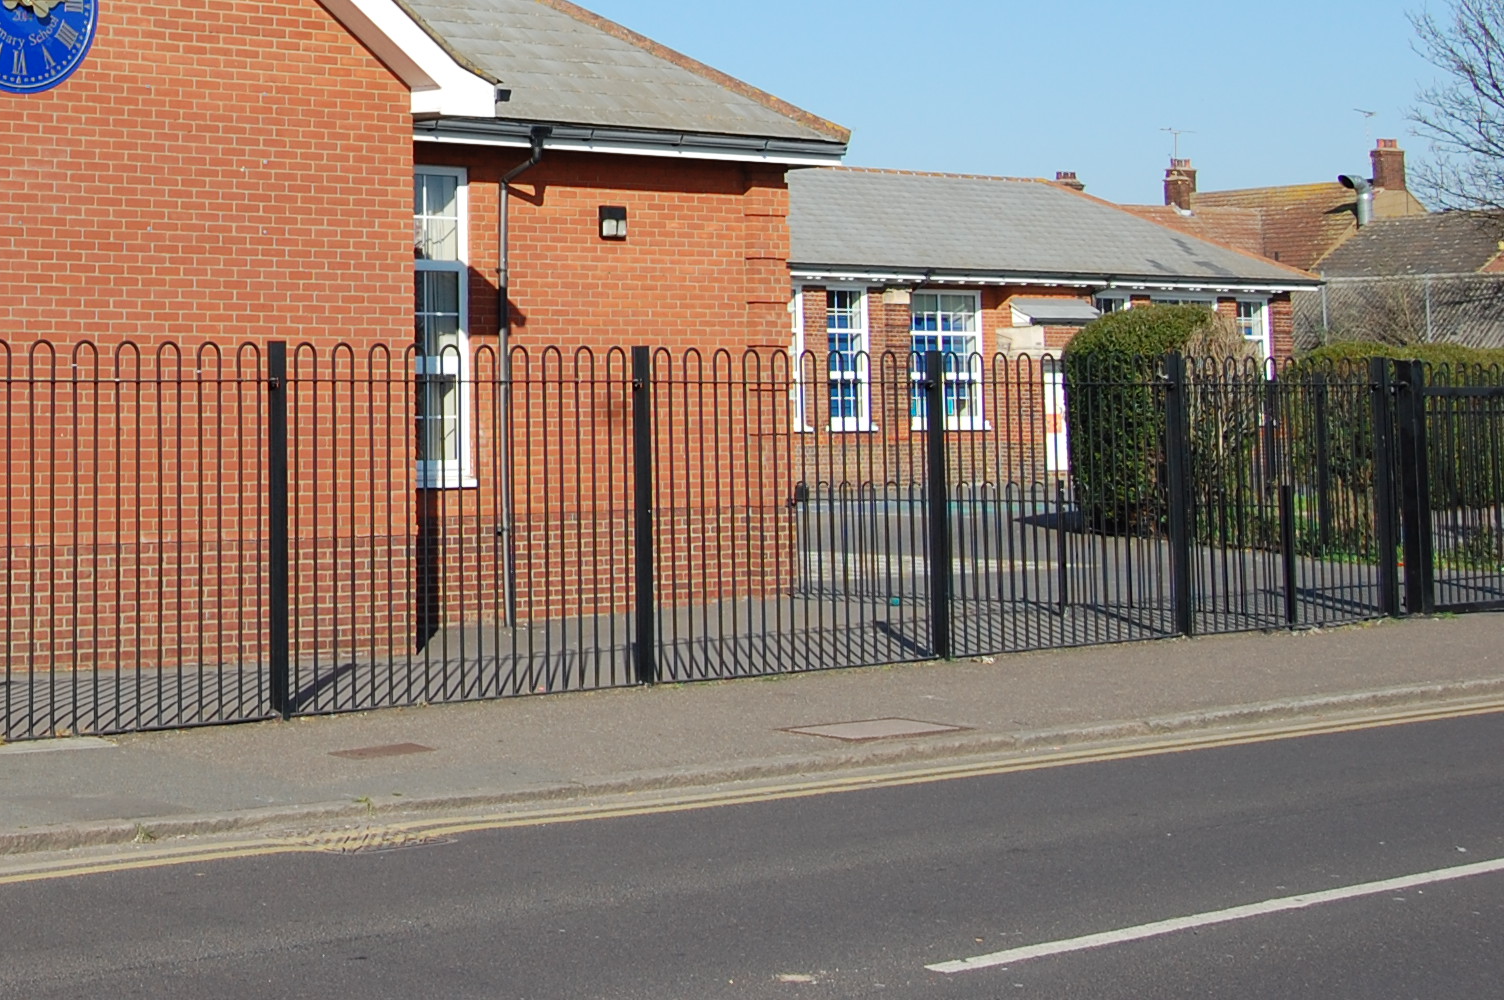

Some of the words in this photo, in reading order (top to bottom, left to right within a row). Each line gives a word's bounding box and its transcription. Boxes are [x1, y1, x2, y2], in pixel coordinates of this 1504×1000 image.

[28, 15, 59, 46] School
[55, 20, 79, 50] IIII
[12, 49, 27, 75] VI
[41, 44, 56, 70] V
